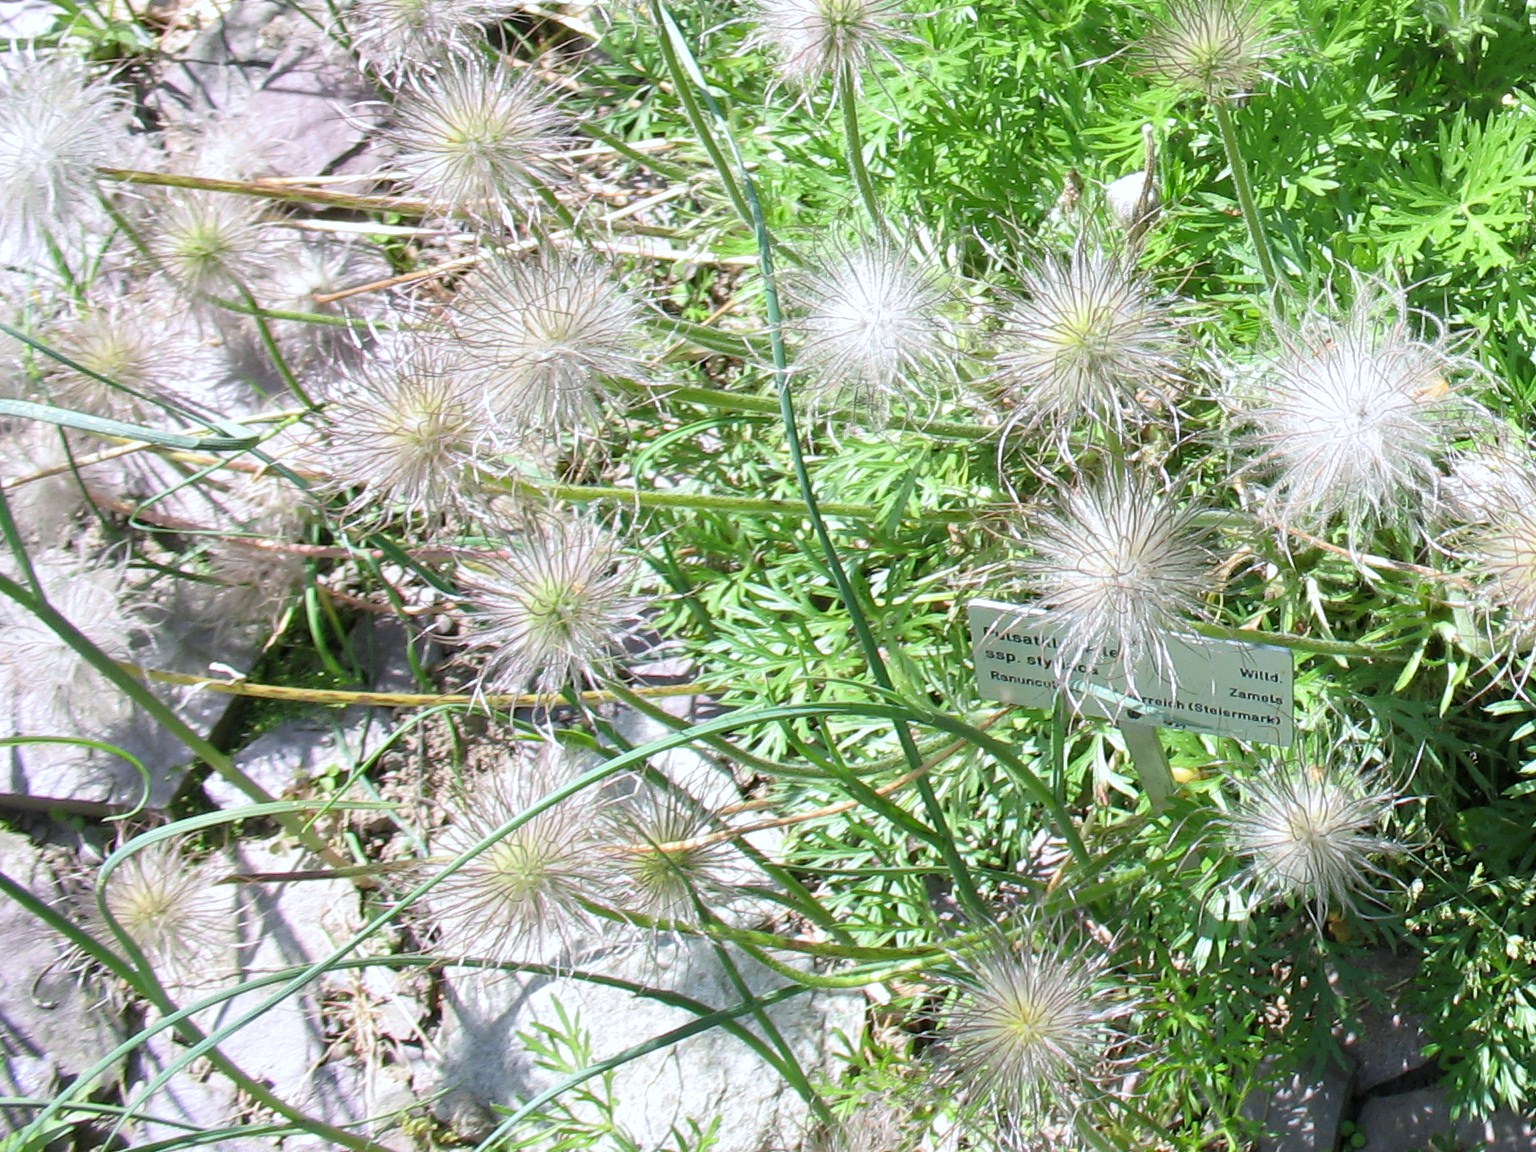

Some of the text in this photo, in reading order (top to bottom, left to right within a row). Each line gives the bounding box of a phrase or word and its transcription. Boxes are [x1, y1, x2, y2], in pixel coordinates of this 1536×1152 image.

[985, 650, 1021, 665] ssp.
[1229, 686, 1284, 706] Zamels
[1239, 667, 1283, 684] Willd.
[1188, 702, 1281, 726] (Steiermark)
